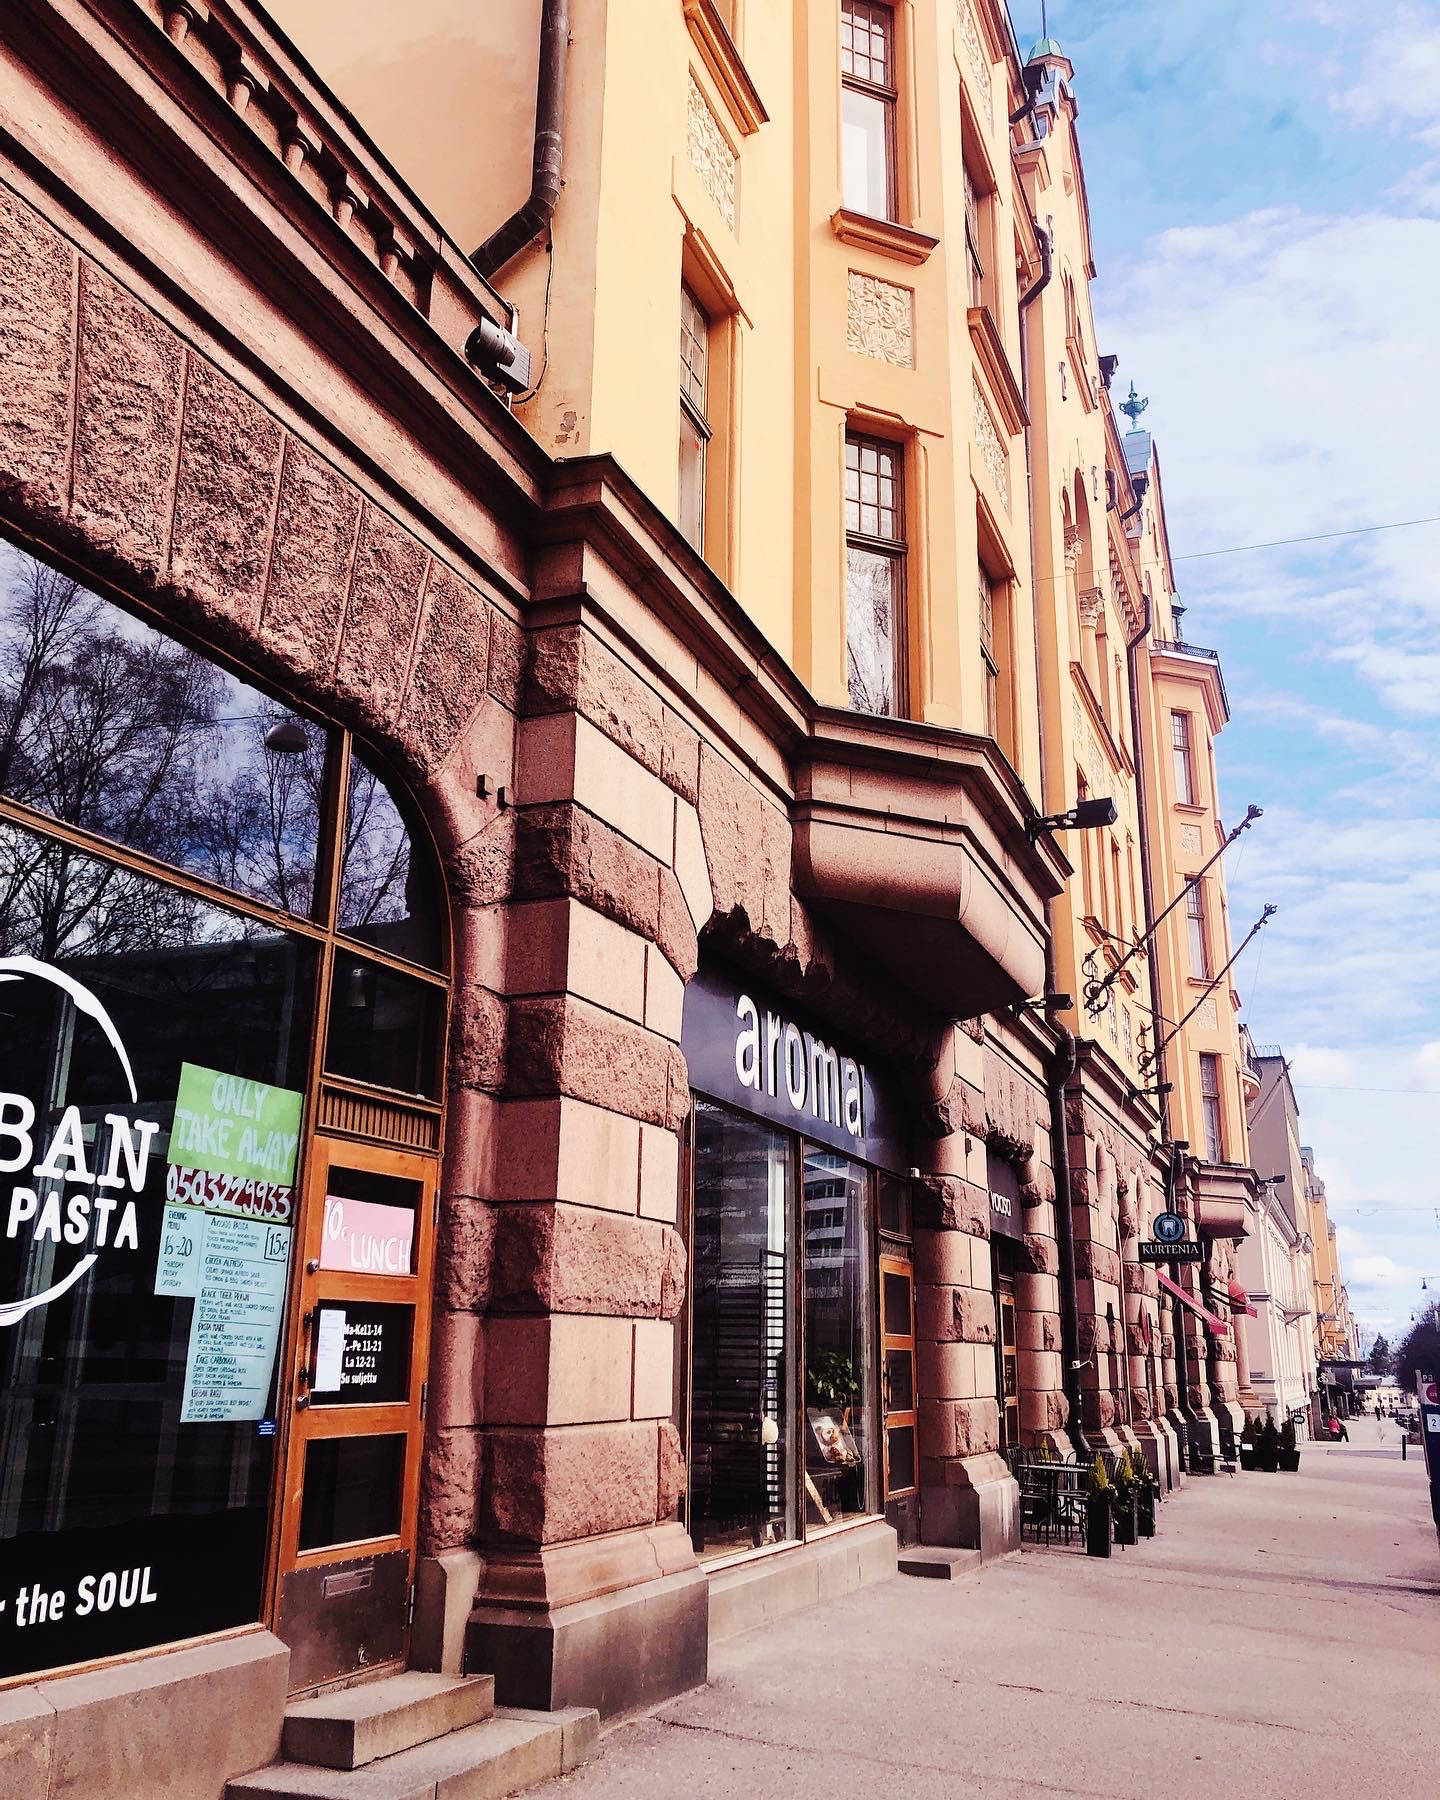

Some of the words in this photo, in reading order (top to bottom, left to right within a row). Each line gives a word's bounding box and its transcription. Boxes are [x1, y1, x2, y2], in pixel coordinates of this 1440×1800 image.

[735, 994, 865, 1138] aroma
[210, 1074, 269, 1121] ONLY
[175, 1108, 234, 1160] TAKE
[237, 1125, 298, 1174] AWAY
[166, 1164, 292, 1220] 0503229933
[7, 1186, 139, 1250] PASTA
[350, 1233, 410, 1273] LUNCH
[1142, 1244, 1198, 1254] KURTENIA
[341, 1372, 350, 1384] Su
[351, 1372, 378, 1386] suljettu
[345, 1356, 354, 1368] La
[356, 1356, 376, 1368] 12-21
[1431, 1418, 1437, 1427] 2
[16, 1584, 66, 1626] the
[75, 1566, 157, 1616] SOUL
